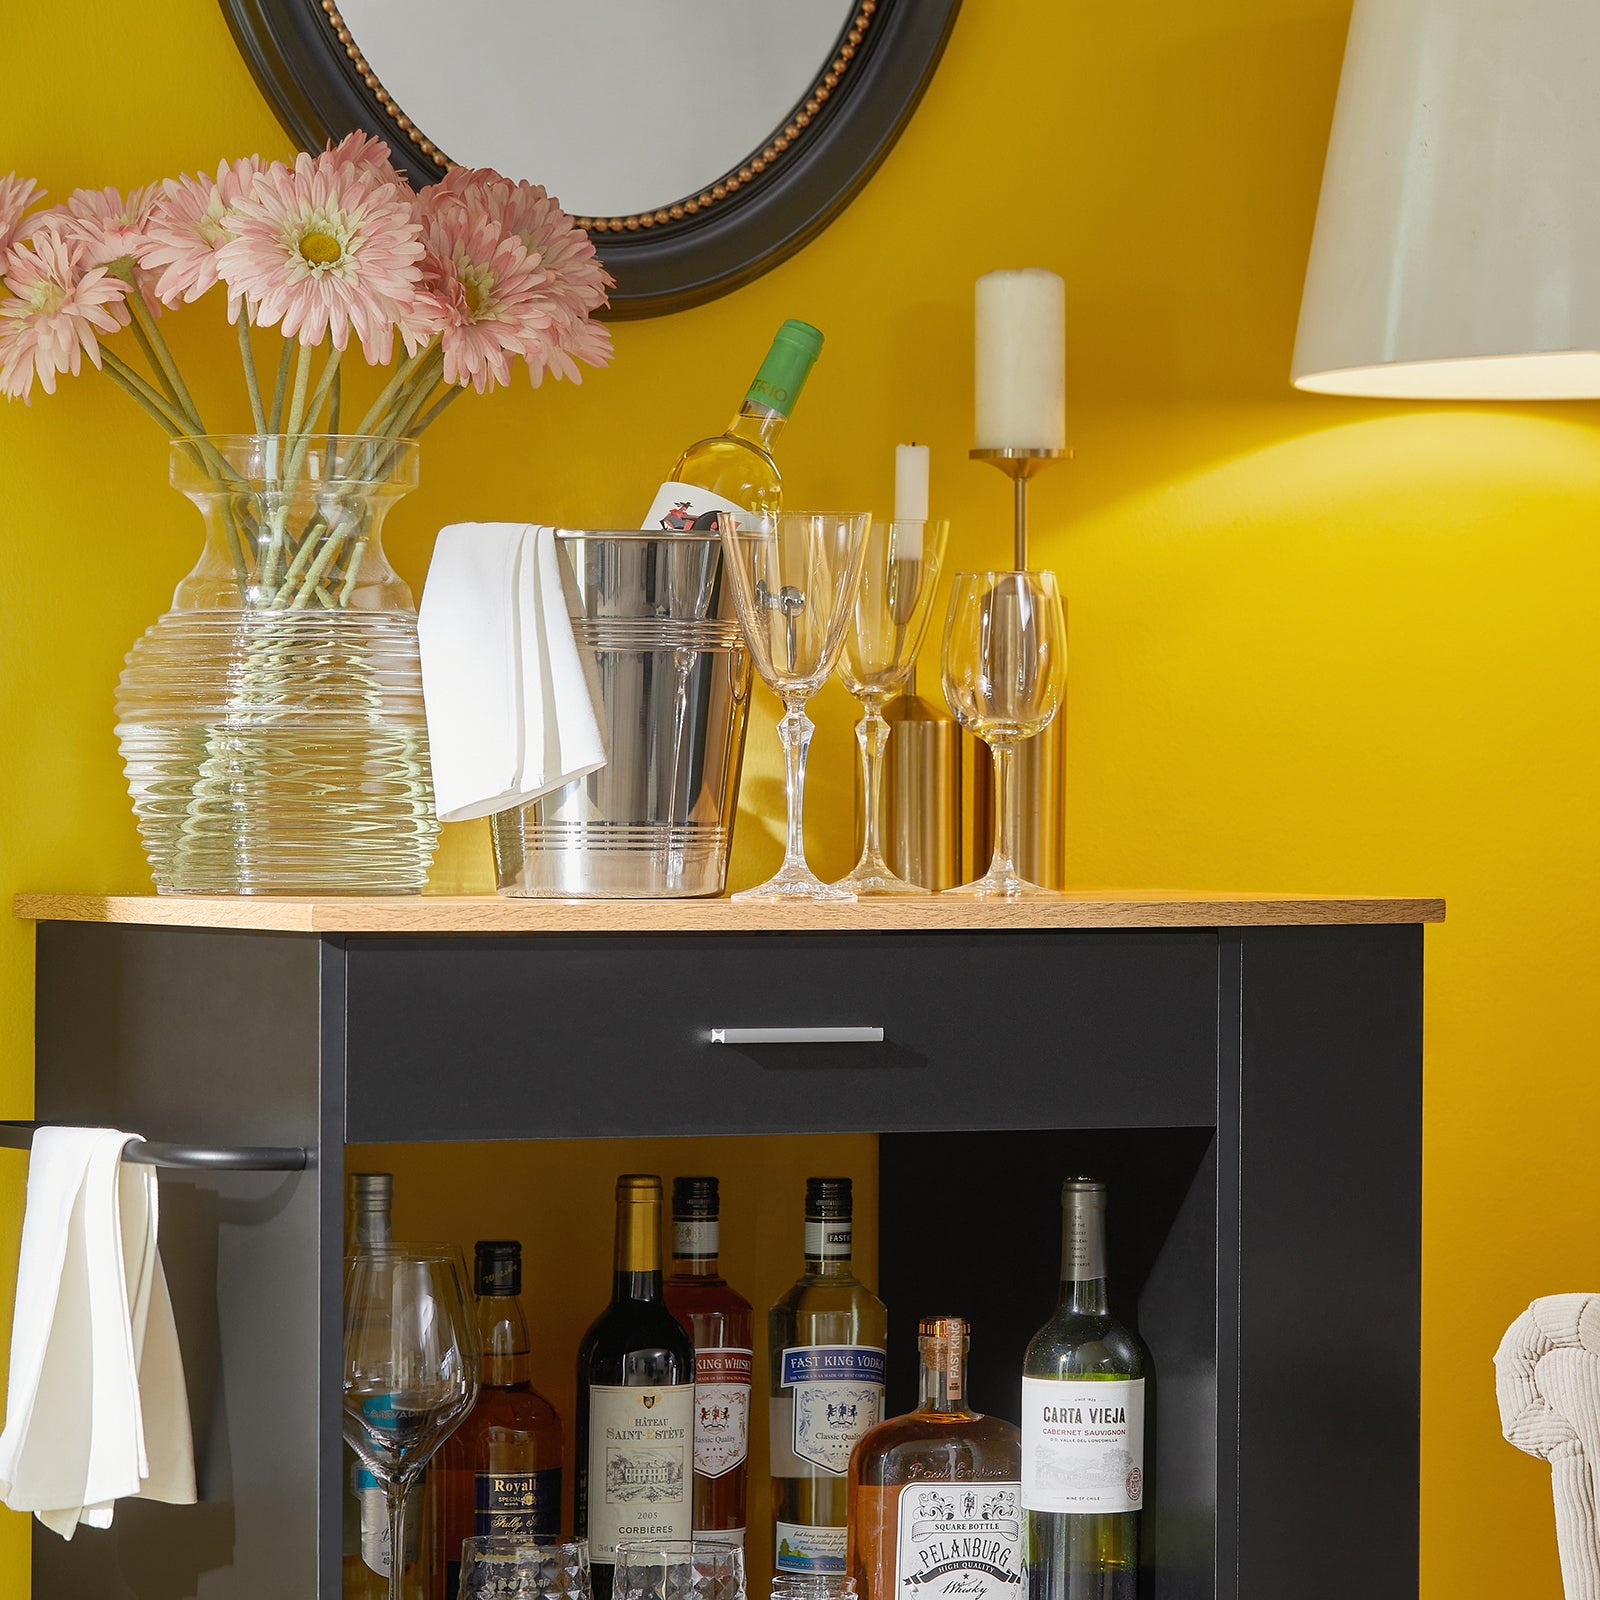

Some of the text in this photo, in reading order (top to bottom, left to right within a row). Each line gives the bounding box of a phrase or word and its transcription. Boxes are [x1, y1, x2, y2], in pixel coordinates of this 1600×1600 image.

[950, 1322, 961, 1350] KING
[697, 1358, 722, 1370] KING
[791, 1355, 884, 1369] FAST KING VODKA
[950, 1351, 960, 1379] FAST
[1043, 1406, 1126, 1424] CARTA VIEJA
[815, 1432, 840, 1440] Classic
[1042, 1428, 1126, 1437] CABERNET SAUVIGNON
[637, 1511, 658, 1520] 2005
[618, 1525, 673, 1535] CORBIÈRES
[935, 1523, 966, 1531] SQUARE
[918, 1537, 1012, 1568] PELANBURG
[939, 1562, 995, 1573] HIGH QUALITY
[941, 1579, 988, 1597] Whisky
